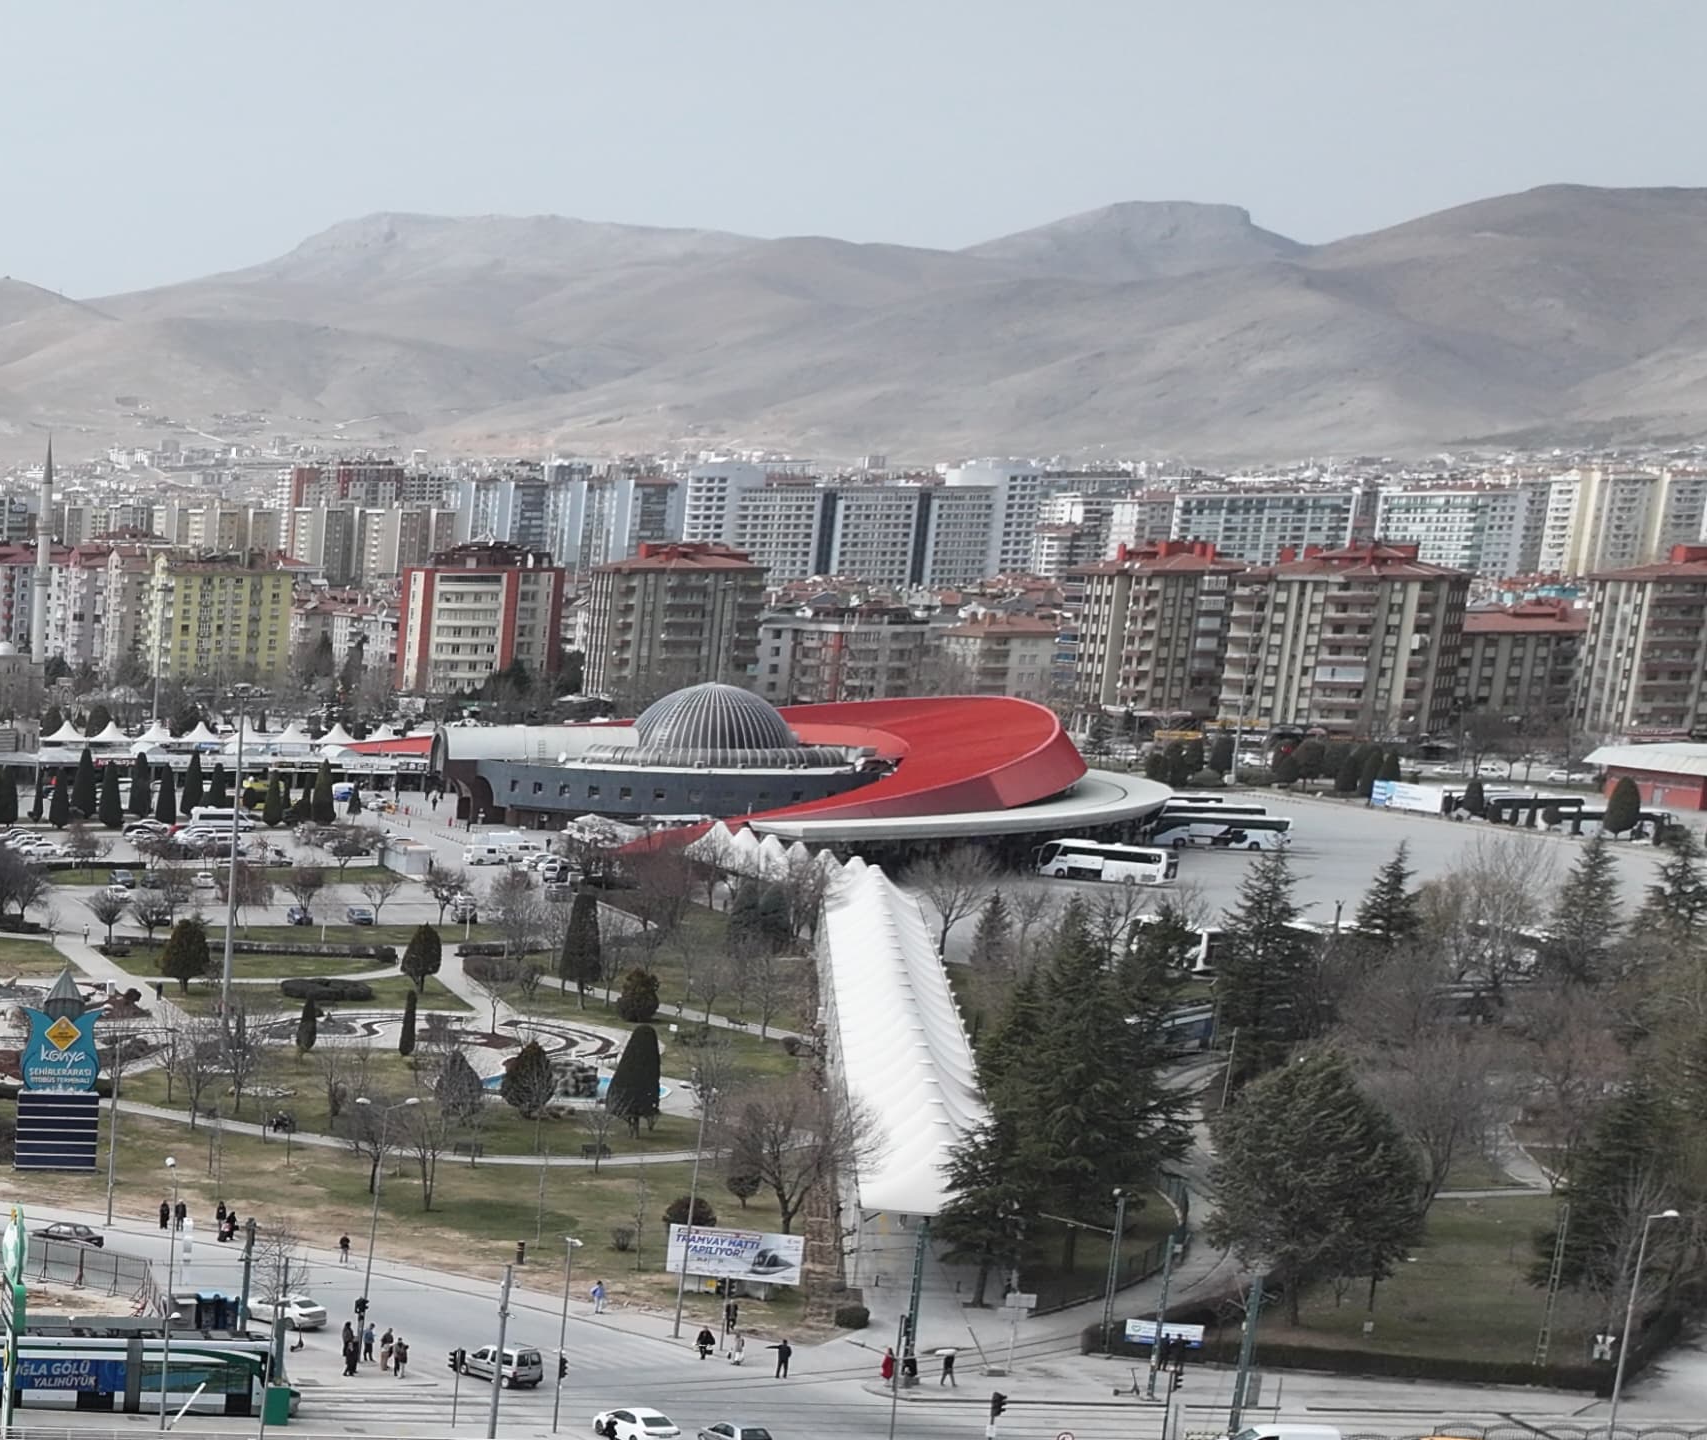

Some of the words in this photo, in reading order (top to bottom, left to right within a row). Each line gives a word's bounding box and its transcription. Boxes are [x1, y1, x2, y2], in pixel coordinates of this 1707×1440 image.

[676, 1234, 727, 1247] TRAMVAY
[727, 1239, 761, 1250] HATTI
[51, 1360, 91, 1376] GÖLÜ
